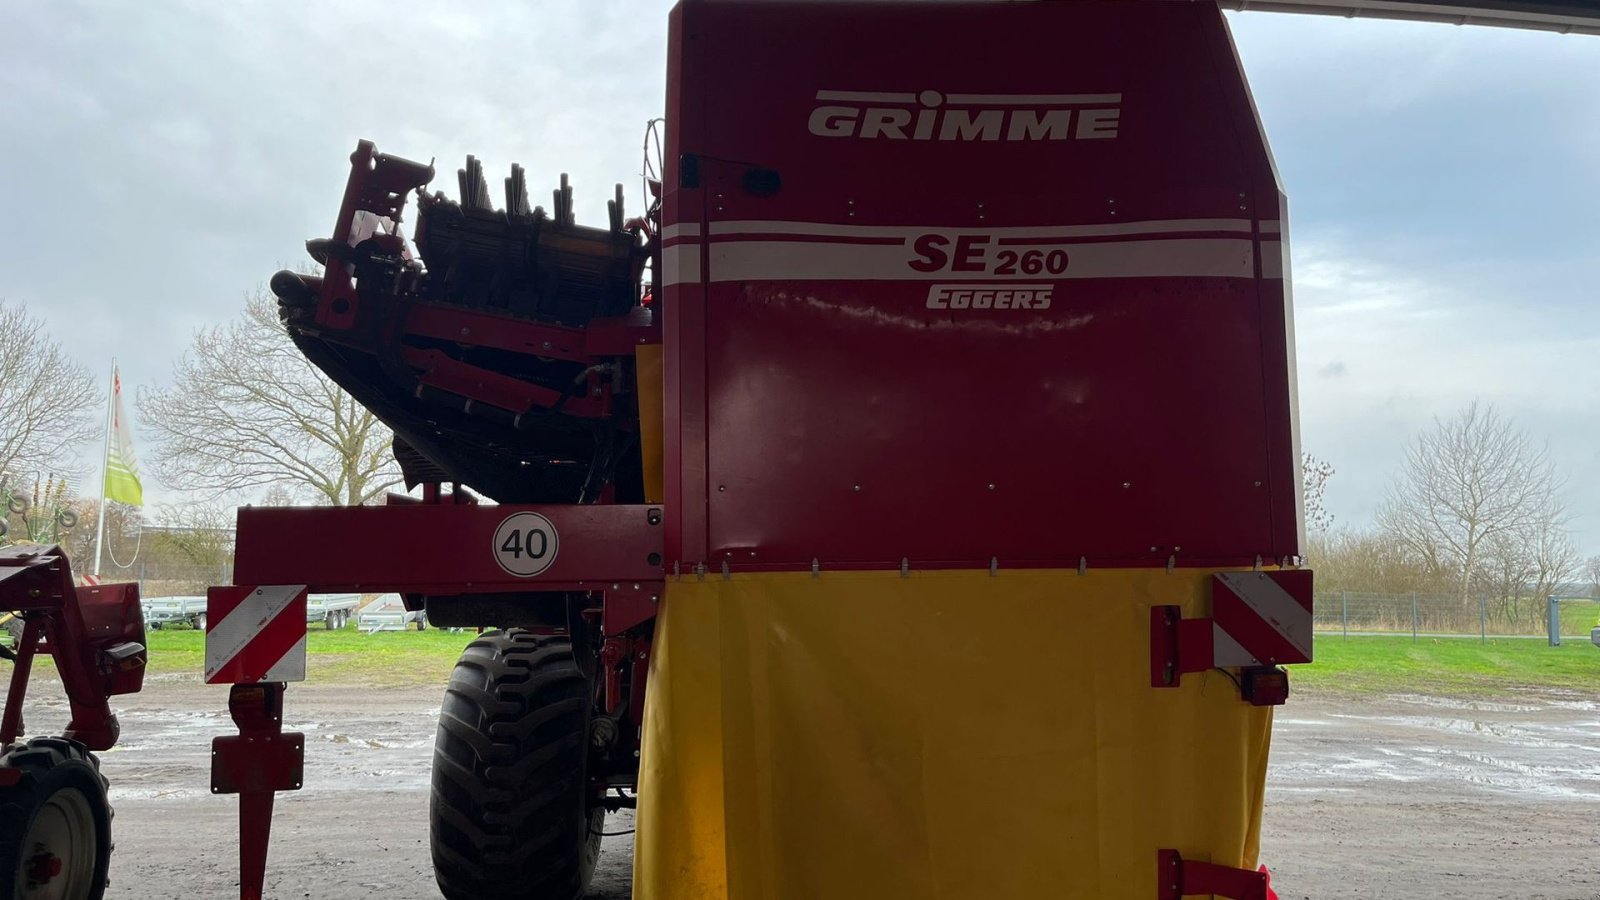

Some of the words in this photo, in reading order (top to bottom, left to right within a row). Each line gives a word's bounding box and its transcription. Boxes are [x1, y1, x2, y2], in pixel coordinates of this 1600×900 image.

[908, 233, 991, 272] SE
[994, 249, 1068, 275] 260
[926, 283, 1054, 310] EGGERS
[502, 528, 548, 559] 40
